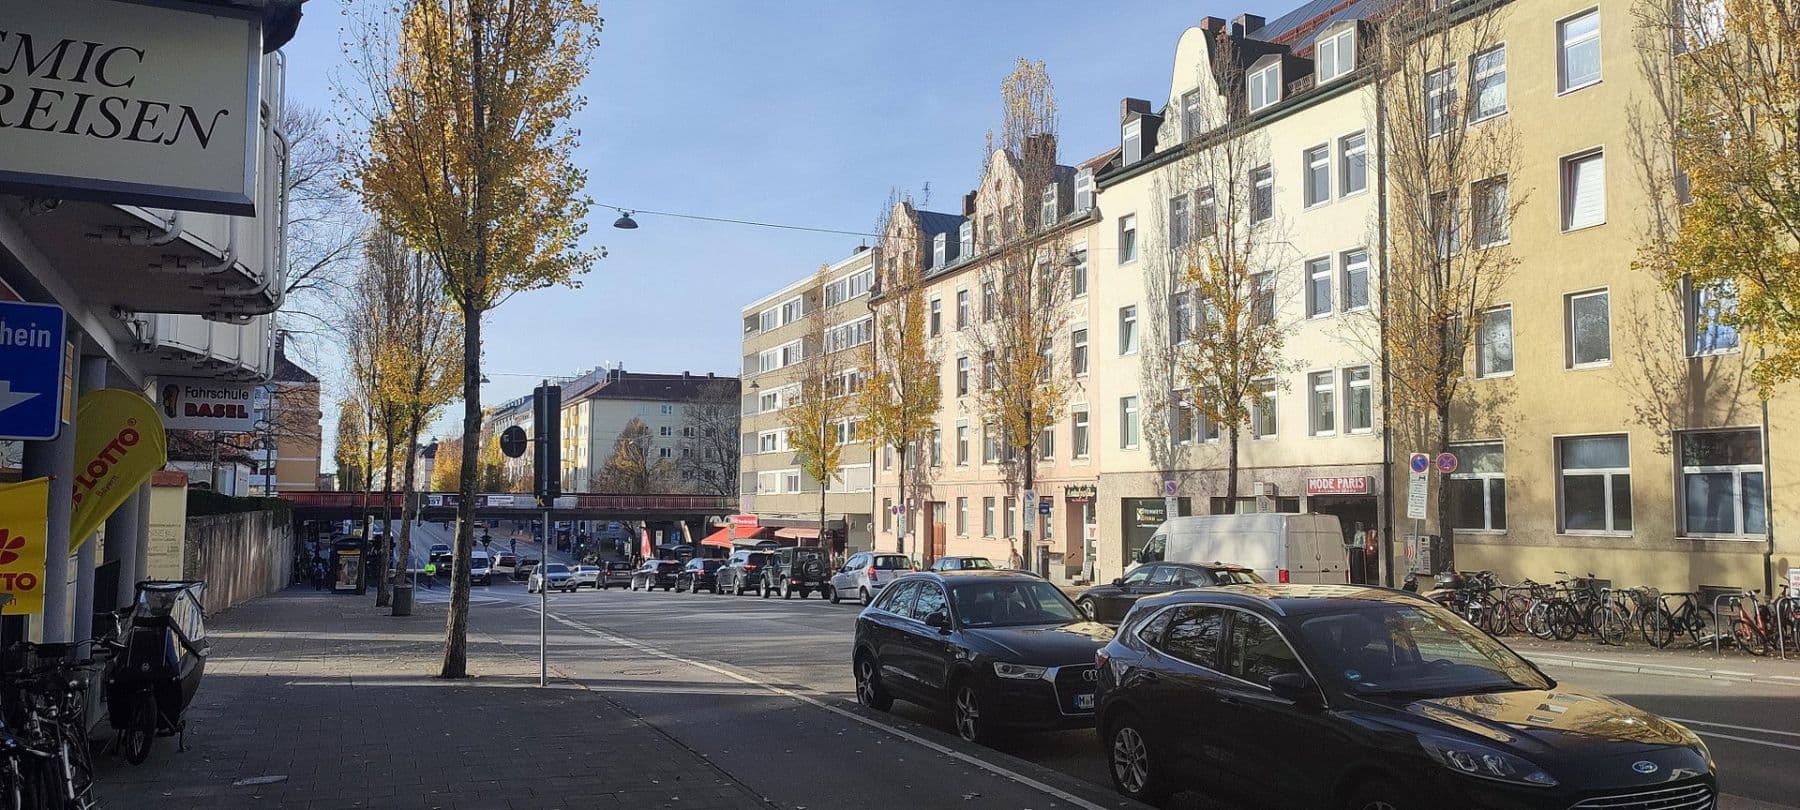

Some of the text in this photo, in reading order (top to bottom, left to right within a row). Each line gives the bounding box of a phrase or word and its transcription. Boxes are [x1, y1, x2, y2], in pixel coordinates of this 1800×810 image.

[0, 31, 145, 88] MIC
[185, 386, 249, 400] Fahrschule
[1310, 477, 1364, 489] MODE PARIS
[0, 573, 37, 591] TO
